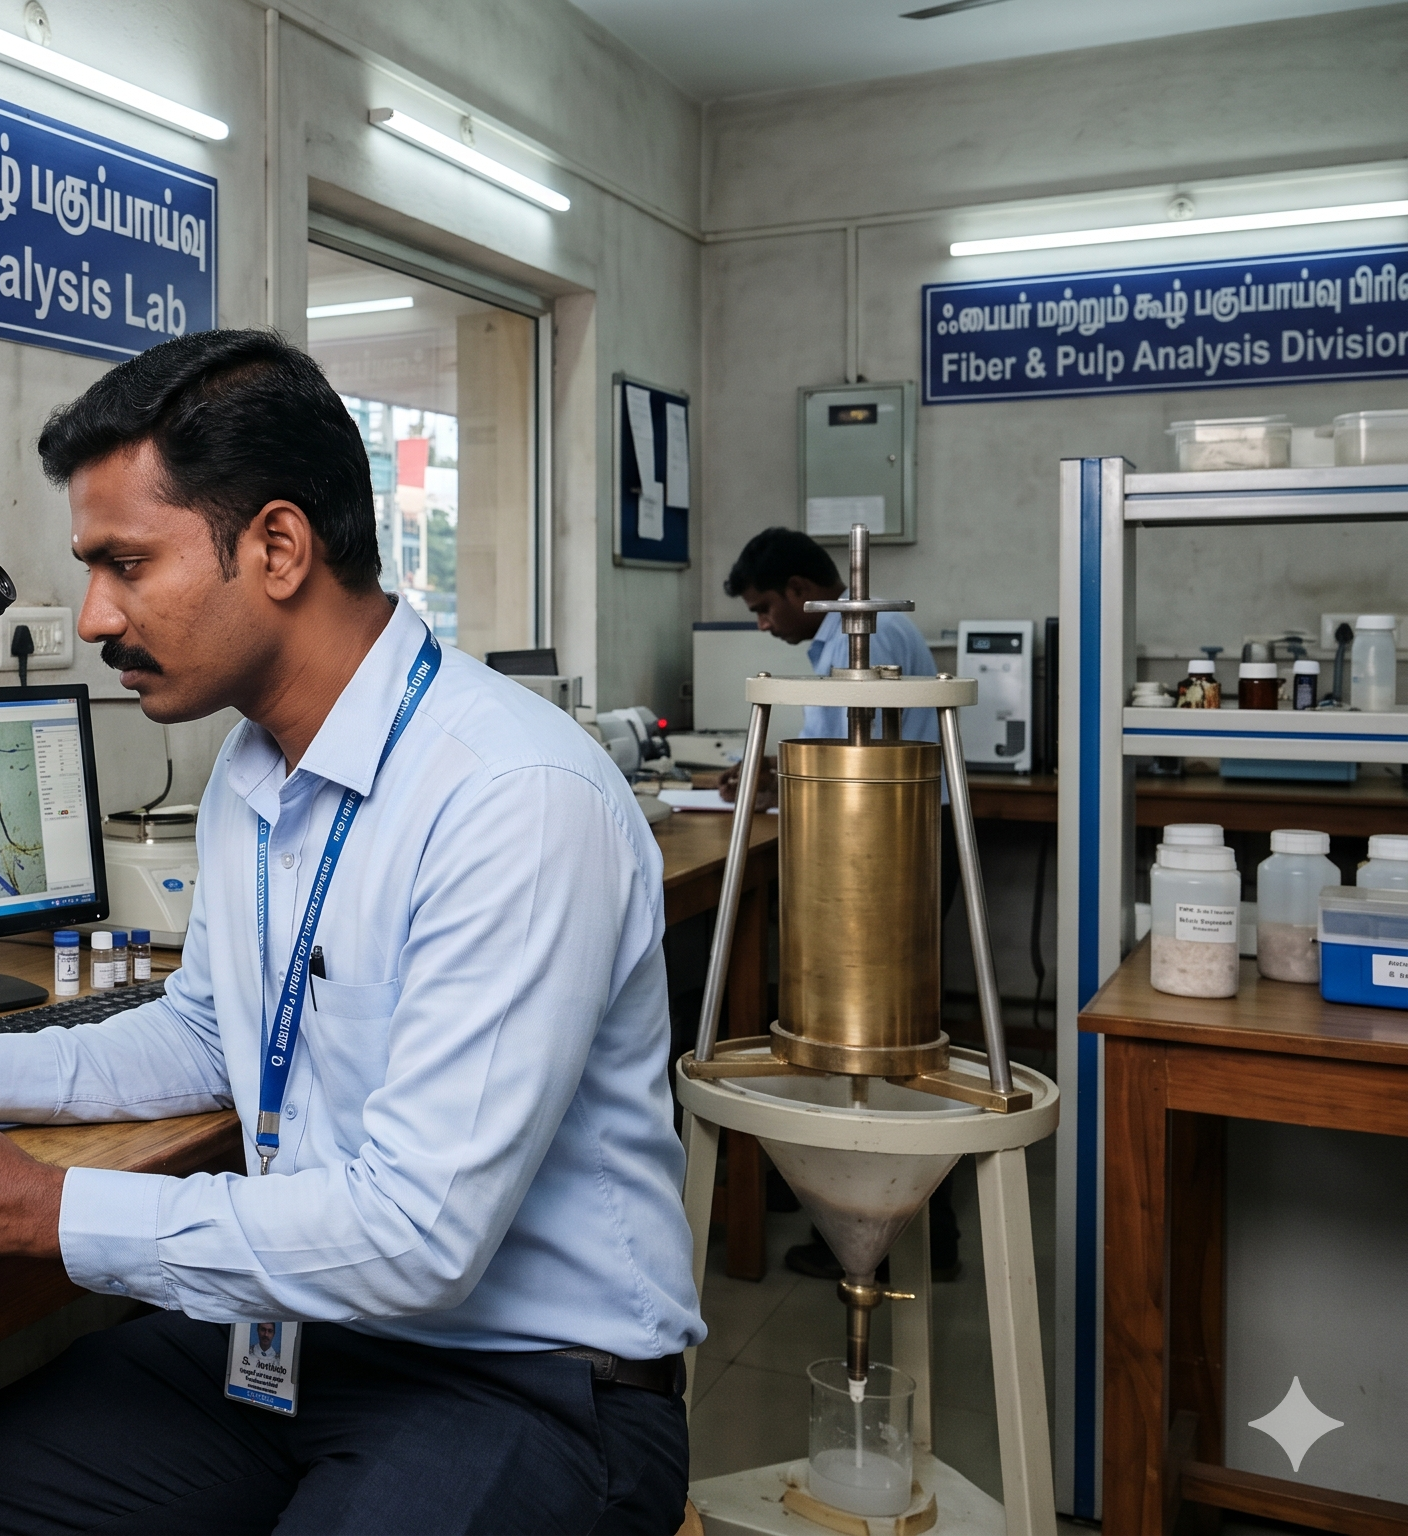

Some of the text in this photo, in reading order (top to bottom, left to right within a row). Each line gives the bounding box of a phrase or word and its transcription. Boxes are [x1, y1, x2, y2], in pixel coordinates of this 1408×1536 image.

[31, 165, 206, 272] பகுப்பாய்வு
[124, 273, 187, 337] Lab
[1037, 283, 1130, 336] மற்றும்
[1133, 278, 1189, 330] கூழ்
[1194, 267, 1342, 323] பகுப்பாய்வு
[942, 352, 1017, 384] Fiber
[1025, 347, 1047, 379] &
[1056, 343, 1125, 382] Pulp
[1132, 333, 1271, 376] Analysis
